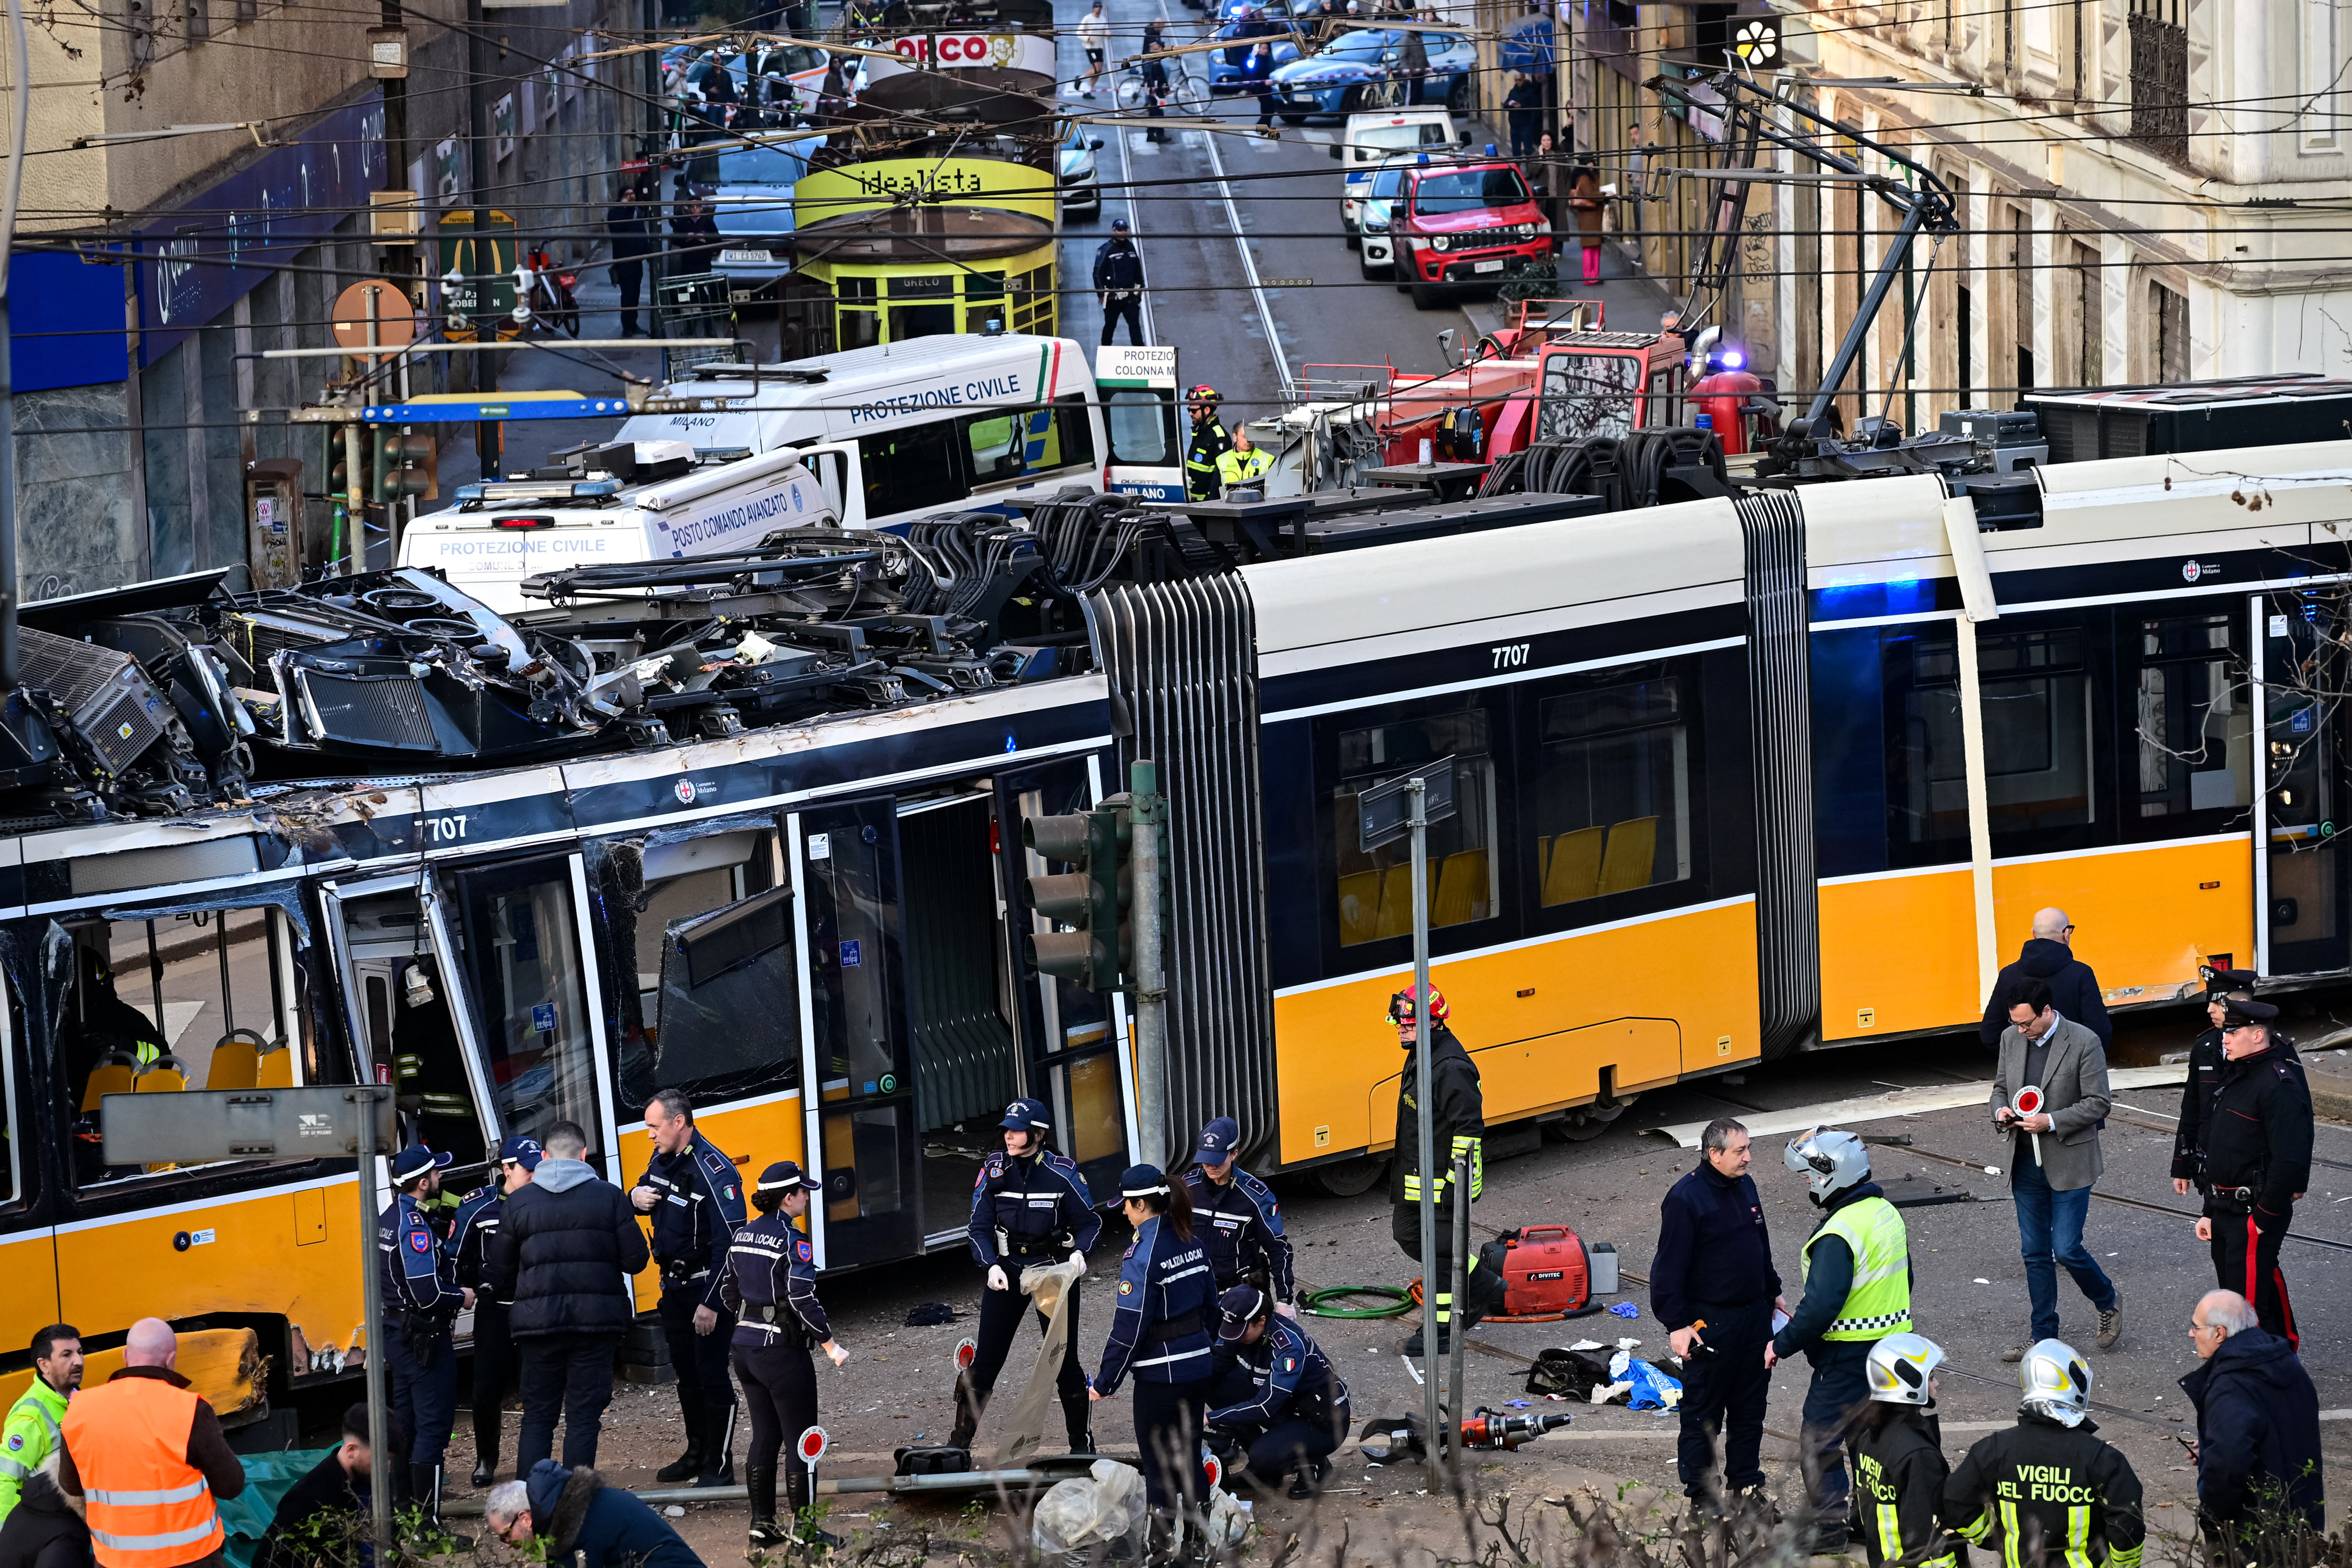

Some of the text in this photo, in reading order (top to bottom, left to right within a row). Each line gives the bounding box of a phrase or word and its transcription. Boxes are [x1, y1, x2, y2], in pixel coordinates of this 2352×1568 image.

[861, 168, 981, 195] idealista
[1116, 366, 1164, 375] COLONNA
[849, 374, 1021, 424] PROTEZIONE CIVILE
[669, 416, 715, 427] MILANO
[1122, 487, 1166, 499] MILANO
[672, 493, 787, 550] POSTO COMANDO AVANZATO
[440, 539, 605, 555] PROTEZIONE CIVILE
[1492, 643, 1530, 669] 7707
[697, 786, 717, 794] Milano
[414, 814, 466, 843] 7707
[755, 1234, 783, 1249] LOCALE
[1160, 1253, 1185, 1270] POLIZIA
[2016, 1464, 2071, 1484] VIGILI
